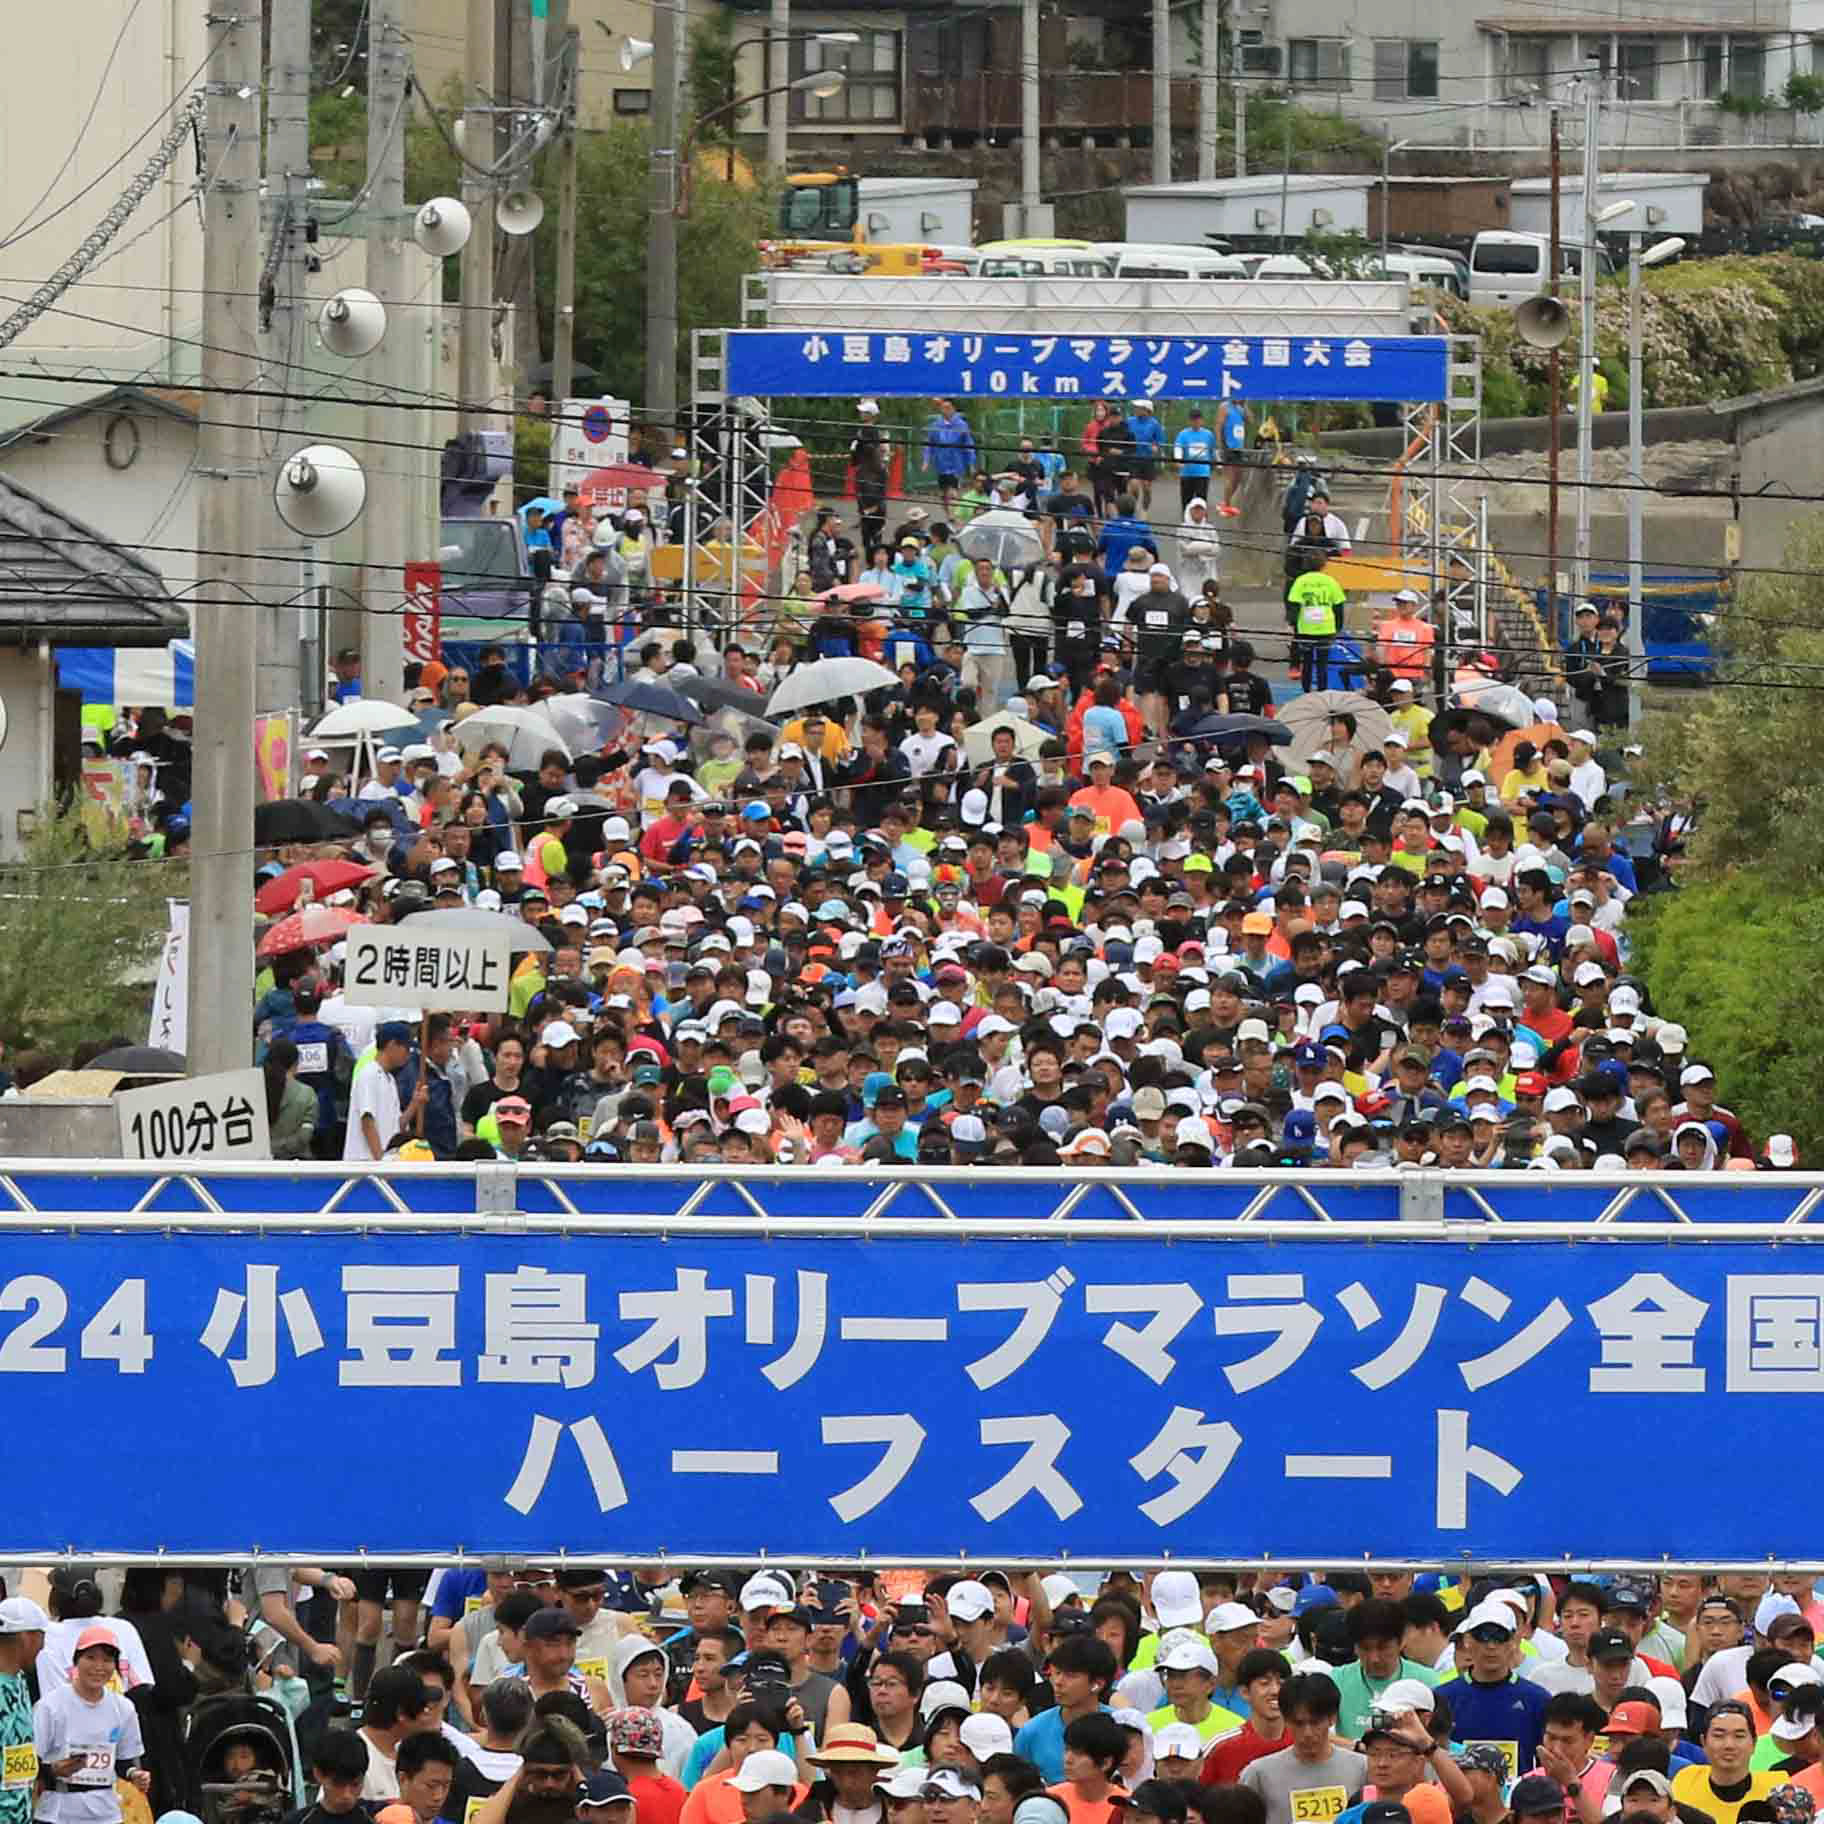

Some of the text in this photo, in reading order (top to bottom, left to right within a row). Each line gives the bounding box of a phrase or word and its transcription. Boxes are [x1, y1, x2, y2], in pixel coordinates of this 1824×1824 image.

[803, 338, 1372, 368] 小豆島オリーブマラソン全国大会
[356, 944, 499, 991] 2時間以上
[131, 1097, 254, 1160] 100分台
[506, 1406, 1523, 1528] ハーフスタート
[6, 1755, 36, 1774] 5662
[1296, 1797, 1344, 1819] 5213
